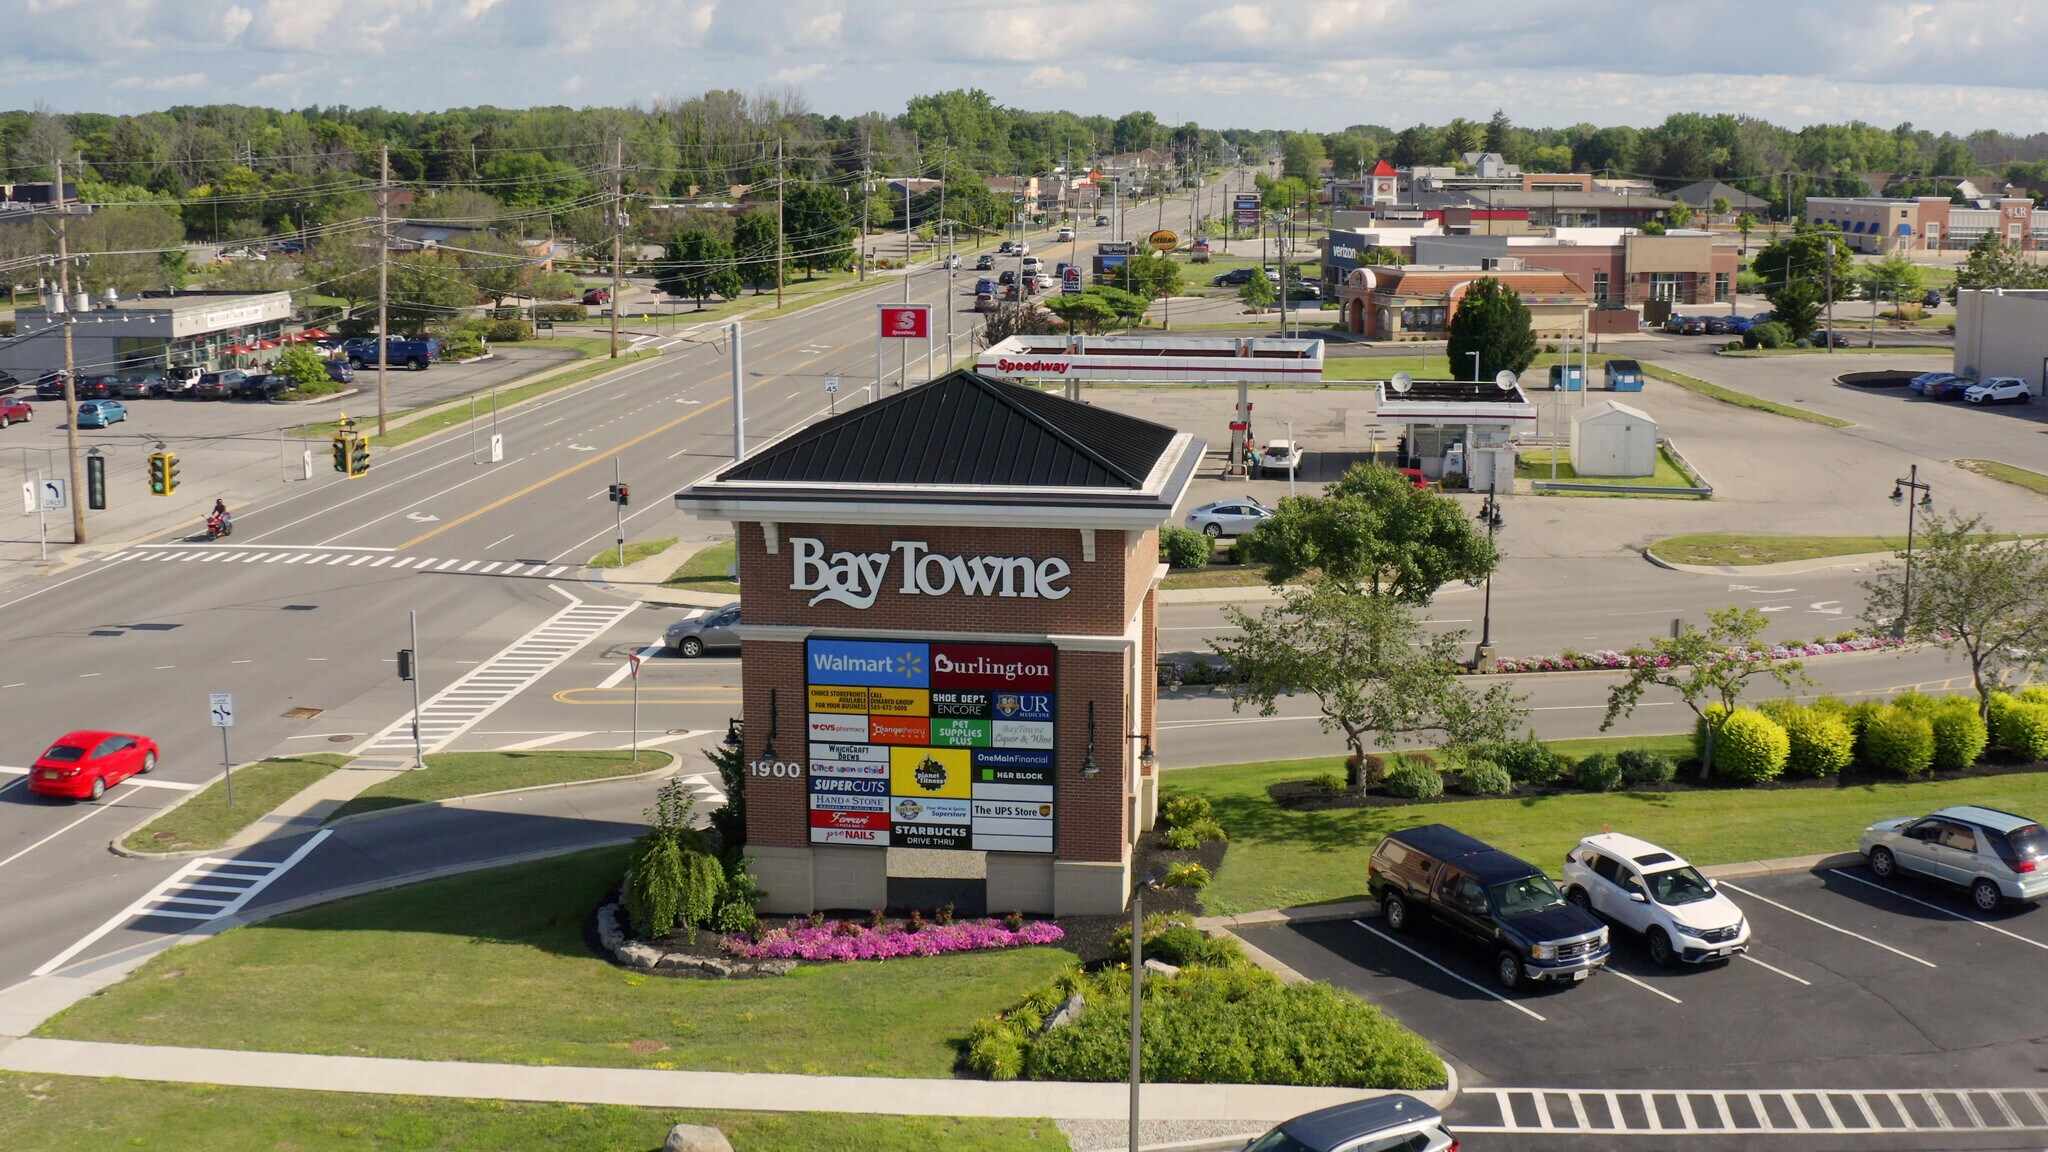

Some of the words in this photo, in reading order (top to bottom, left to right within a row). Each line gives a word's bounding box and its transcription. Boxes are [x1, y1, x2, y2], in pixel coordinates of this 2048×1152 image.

[1333, 244, 1356, 259] verizon
[998, 358, 1069, 374] Speedway
[813, 653, 893, 673] Walmart
[934, 653, 1050, 681] Burlington
[932, 693, 957, 702] SHOE
[961, 694, 987, 704] DEPT.
[1019, 695, 1050, 712] UR
[937, 705, 981, 715] ENCORE
[836, 725, 865, 733] pharmacy
[952, 720, 969, 728] PET
[939, 728, 982, 738] SUPPLIES
[949, 736, 972, 746] PLUS
[994, 733, 1019, 746] Liquor
[1020, 735, 1028, 744] &
[1031, 735, 1052, 744] Wine
[749, 761, 800, 778] 1900
[836, 766, 856, 774] upon
[996, 771, 1014, 779] H&R
[1015, 772, 1043, 780] BLOCK
[814, 779, 885, 793] SUPERCUTS
[931, 810, 967, 818] Superstore
[974, 805, 992, 815] The
[994, 806, 1013, 815] UPS
[1015, 807, 1038, 816] Store
[829, 812, 870, 825] Ferrari
[826, 830, 844, 842] pro
[845, 830, 875, 840] NAILS
[895, 825, 967, 837] STARBUCKS
[907, 837, 931, 845] DRIVE
[933, 838, 955, 846] THRU
